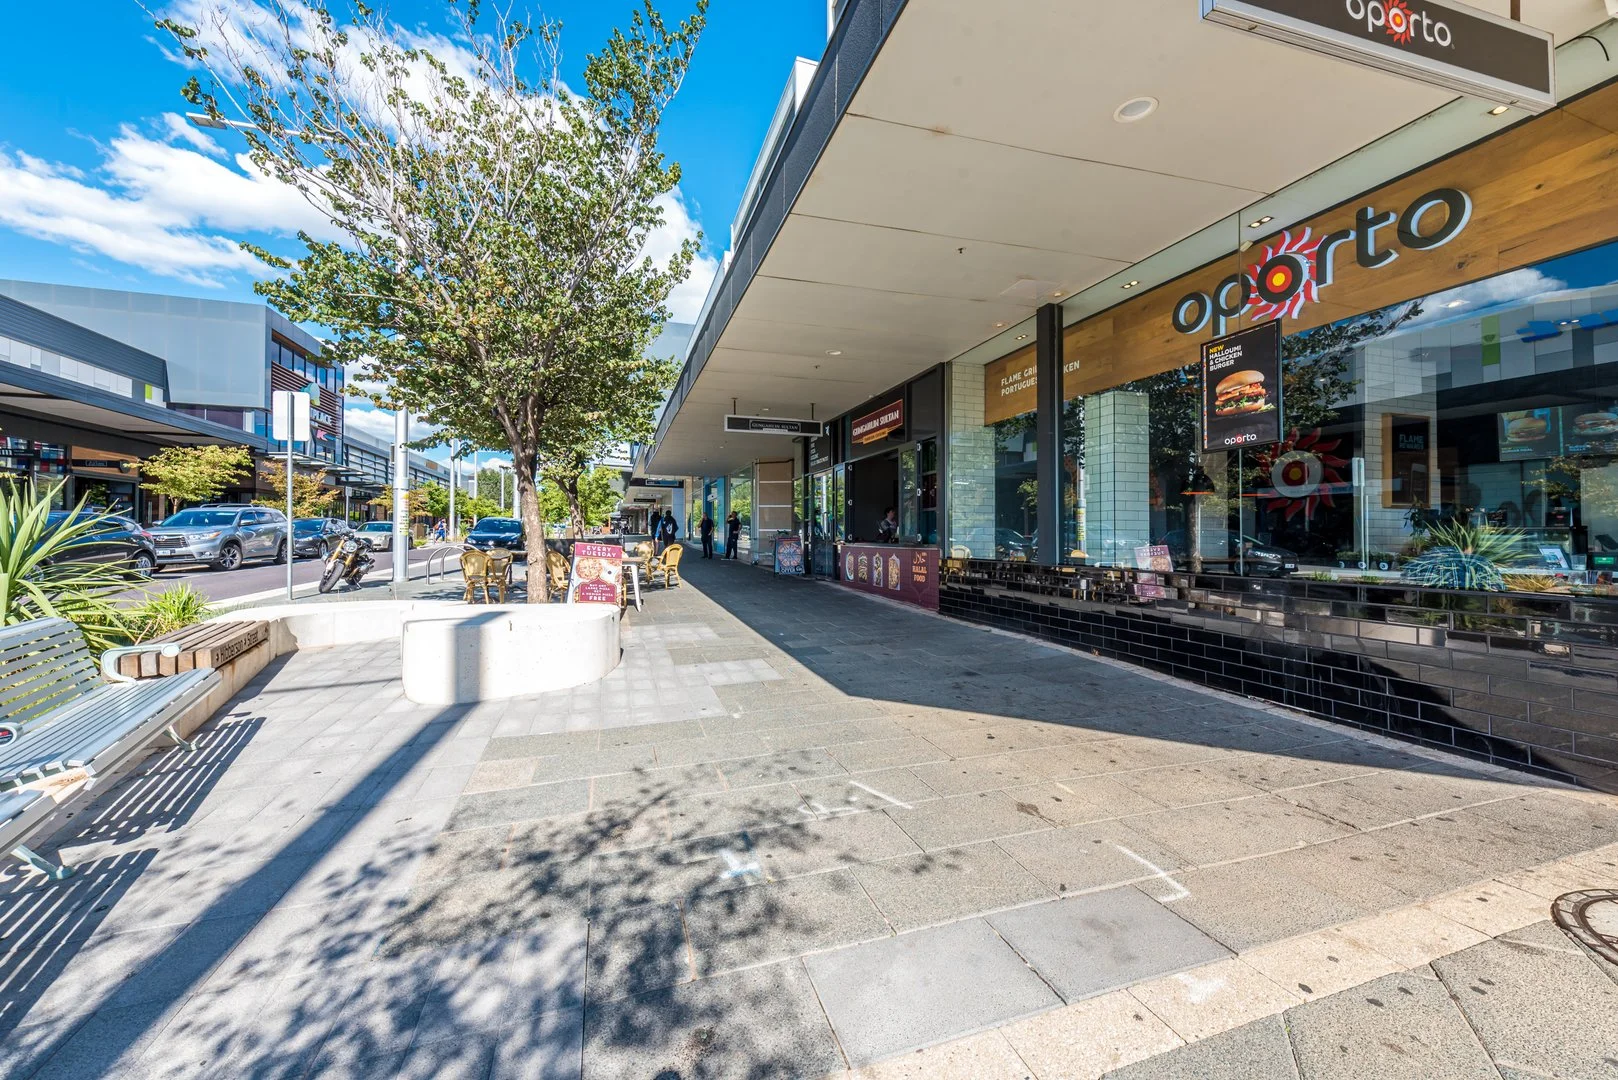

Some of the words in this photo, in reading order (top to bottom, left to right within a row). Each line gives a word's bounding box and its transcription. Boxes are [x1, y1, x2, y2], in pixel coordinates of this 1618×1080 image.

[1345, 0, 1452, 47] oporto
[1172, 188, 1472, 337] oporto
[1209, 344, 1224, 354] NEW
[1209, 345, 1242, 360] HALLOUMI
[1214, 351, 1243, 364] CHICKEN
[1209, 360, 1235, 371] BURGER
[1001, 372, 1021, 386] FLAME
[879, 410, 899, 426] SULTAN
[1224, 433, 1257, 445] oporto
[581, 550, 617, 558] TUESDAY
[912, 565, 927, 574] HALAL
[913, 574, 926, 583] FOOD
